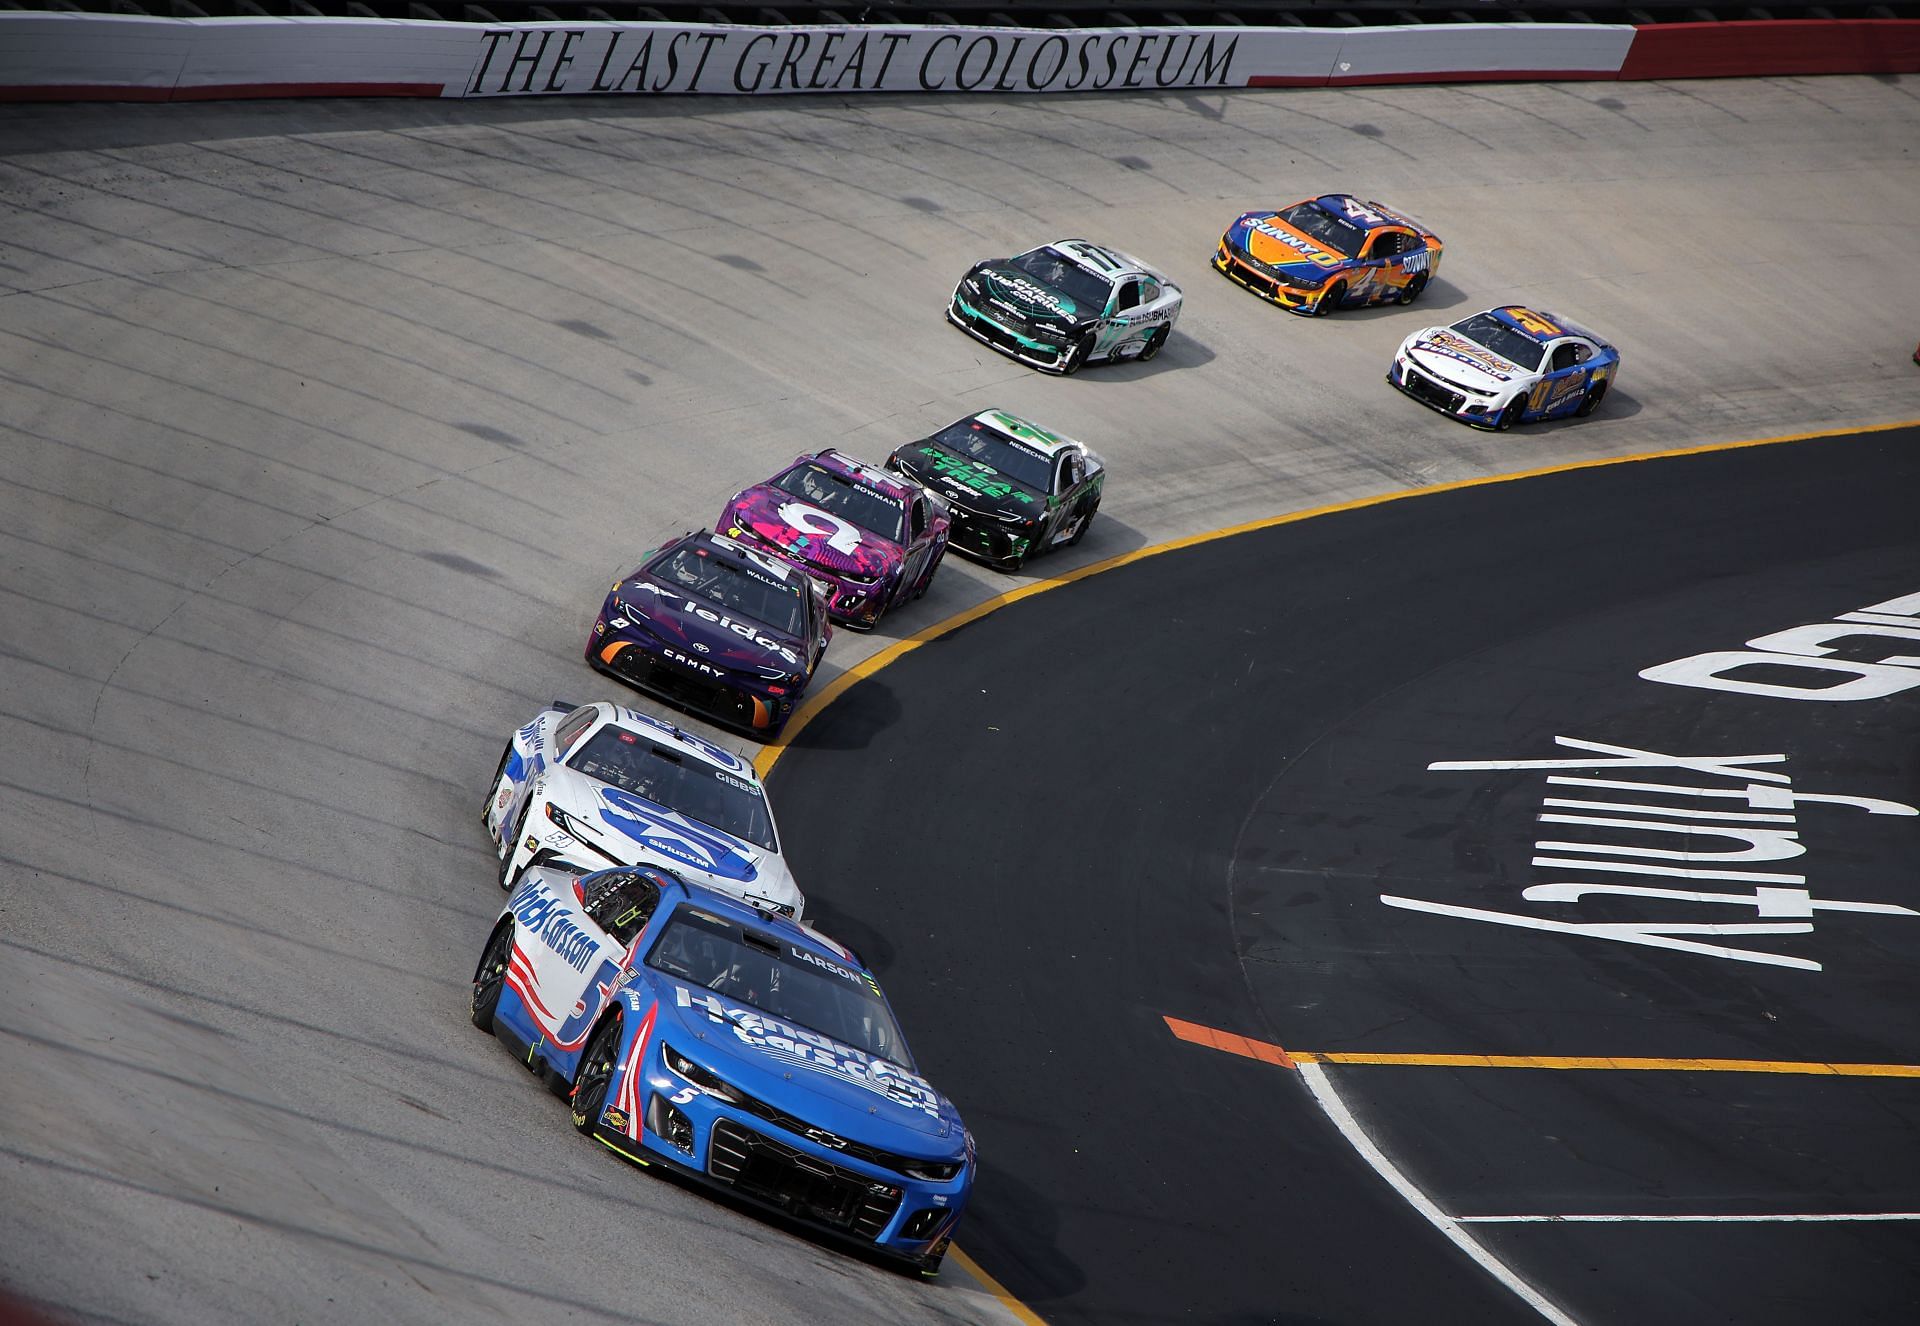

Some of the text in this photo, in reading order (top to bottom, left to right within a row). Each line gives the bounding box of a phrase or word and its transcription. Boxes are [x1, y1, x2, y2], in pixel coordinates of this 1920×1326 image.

[468, 30, 1240, 94] THE LAST GREAT COLOSSEUM
[980, 268, 1078, 325] SUBMARINES
[1013, 278, 1060, 304] BUILD
[1009, 440, 1050, 464] NEMECHEK
[919, 447, 1034, 503] DOLLAR
[932, 460, 1004, 498] TREE
[853, 483, 896, 507] BOWMAN
[746, 569, 788, 591] WALLACE
[684, 601, 798, 664] leidos
[663, 648, 726, 678] CAMRY
[715, 771, 758, 796] GIBBS
[791, 947, 862, 985] LARSON
[669, 1087, 700, 1105] 5
